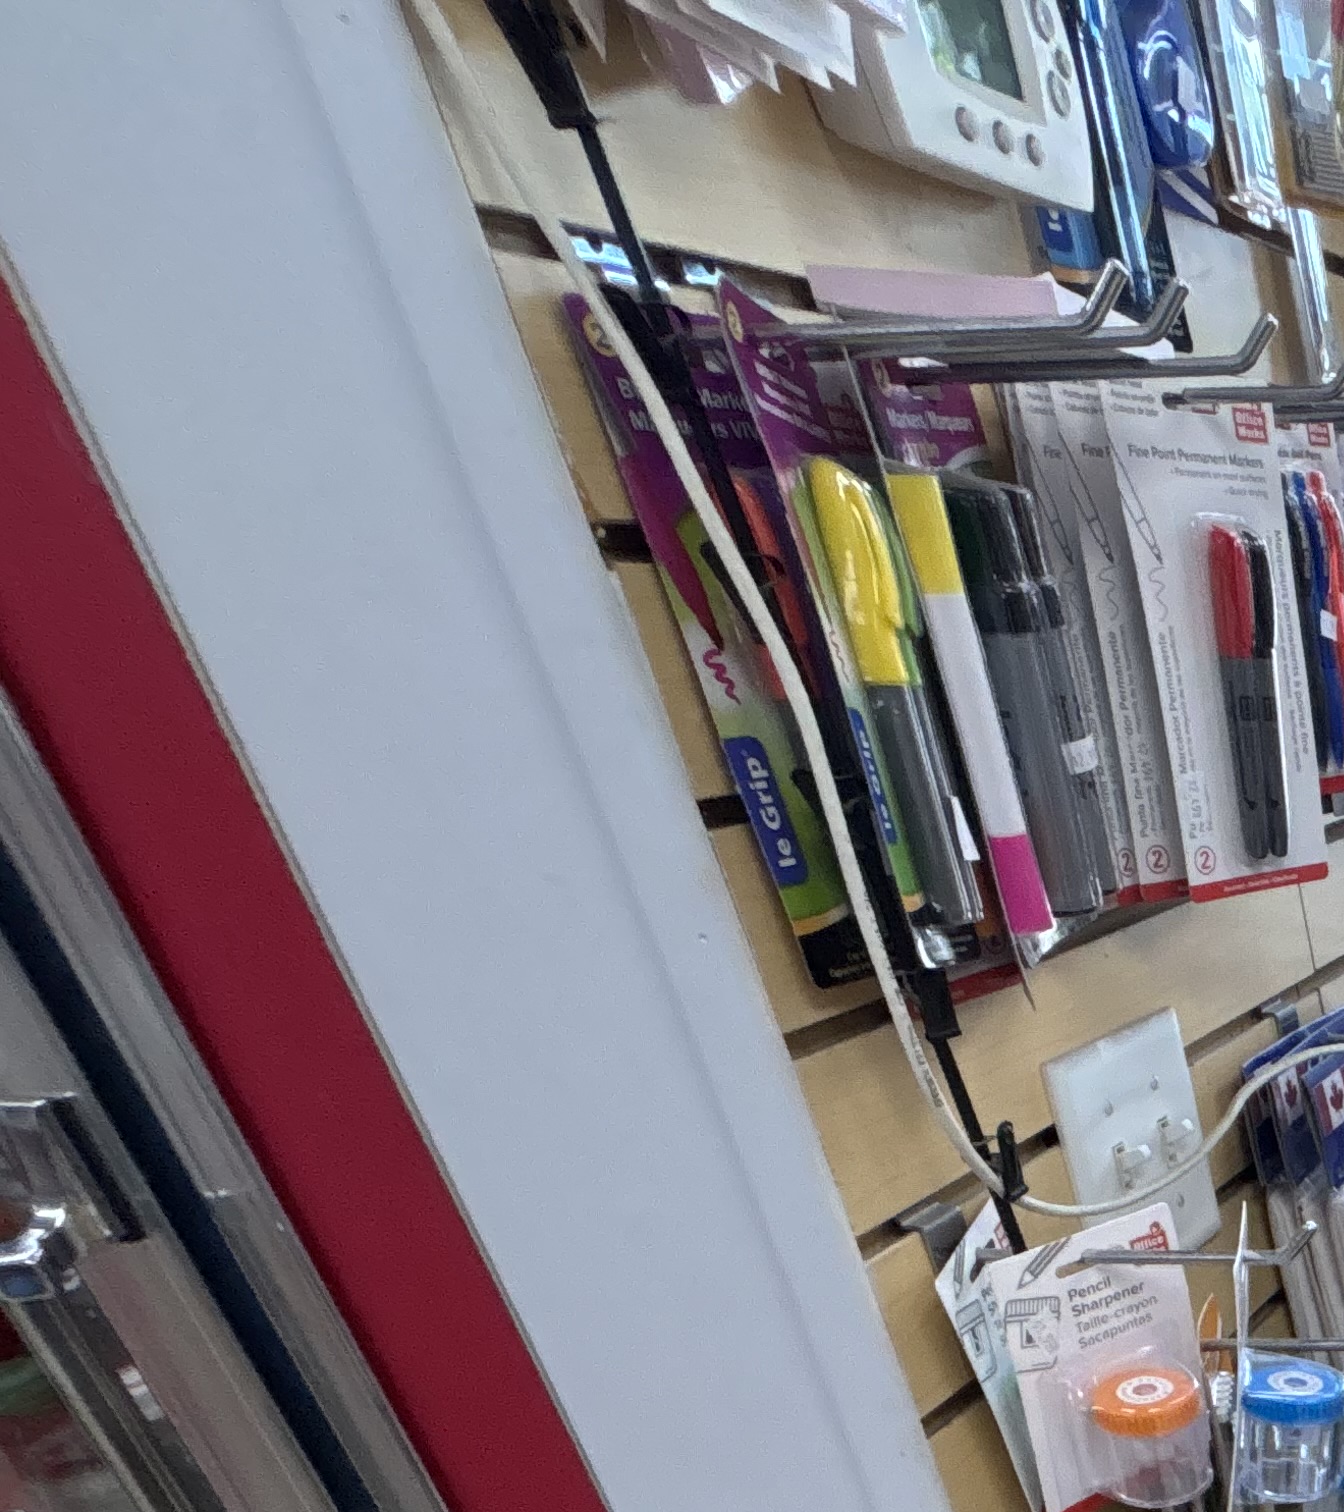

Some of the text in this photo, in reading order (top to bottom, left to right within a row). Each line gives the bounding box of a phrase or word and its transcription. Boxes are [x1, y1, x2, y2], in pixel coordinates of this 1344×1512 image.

[1128, 443, 1265, 469] Fine Point Permanent Markers
[746, 756, 797, 868] le Grip
[1067, 1276, 1112, 1301] Pencil
[1071, 1281, 1145, 1318] Sharpener
[1075, 1294, 1159, 1334] Taille-crayon
[1078, 1312, 1153, 1350] Sacapuntas
